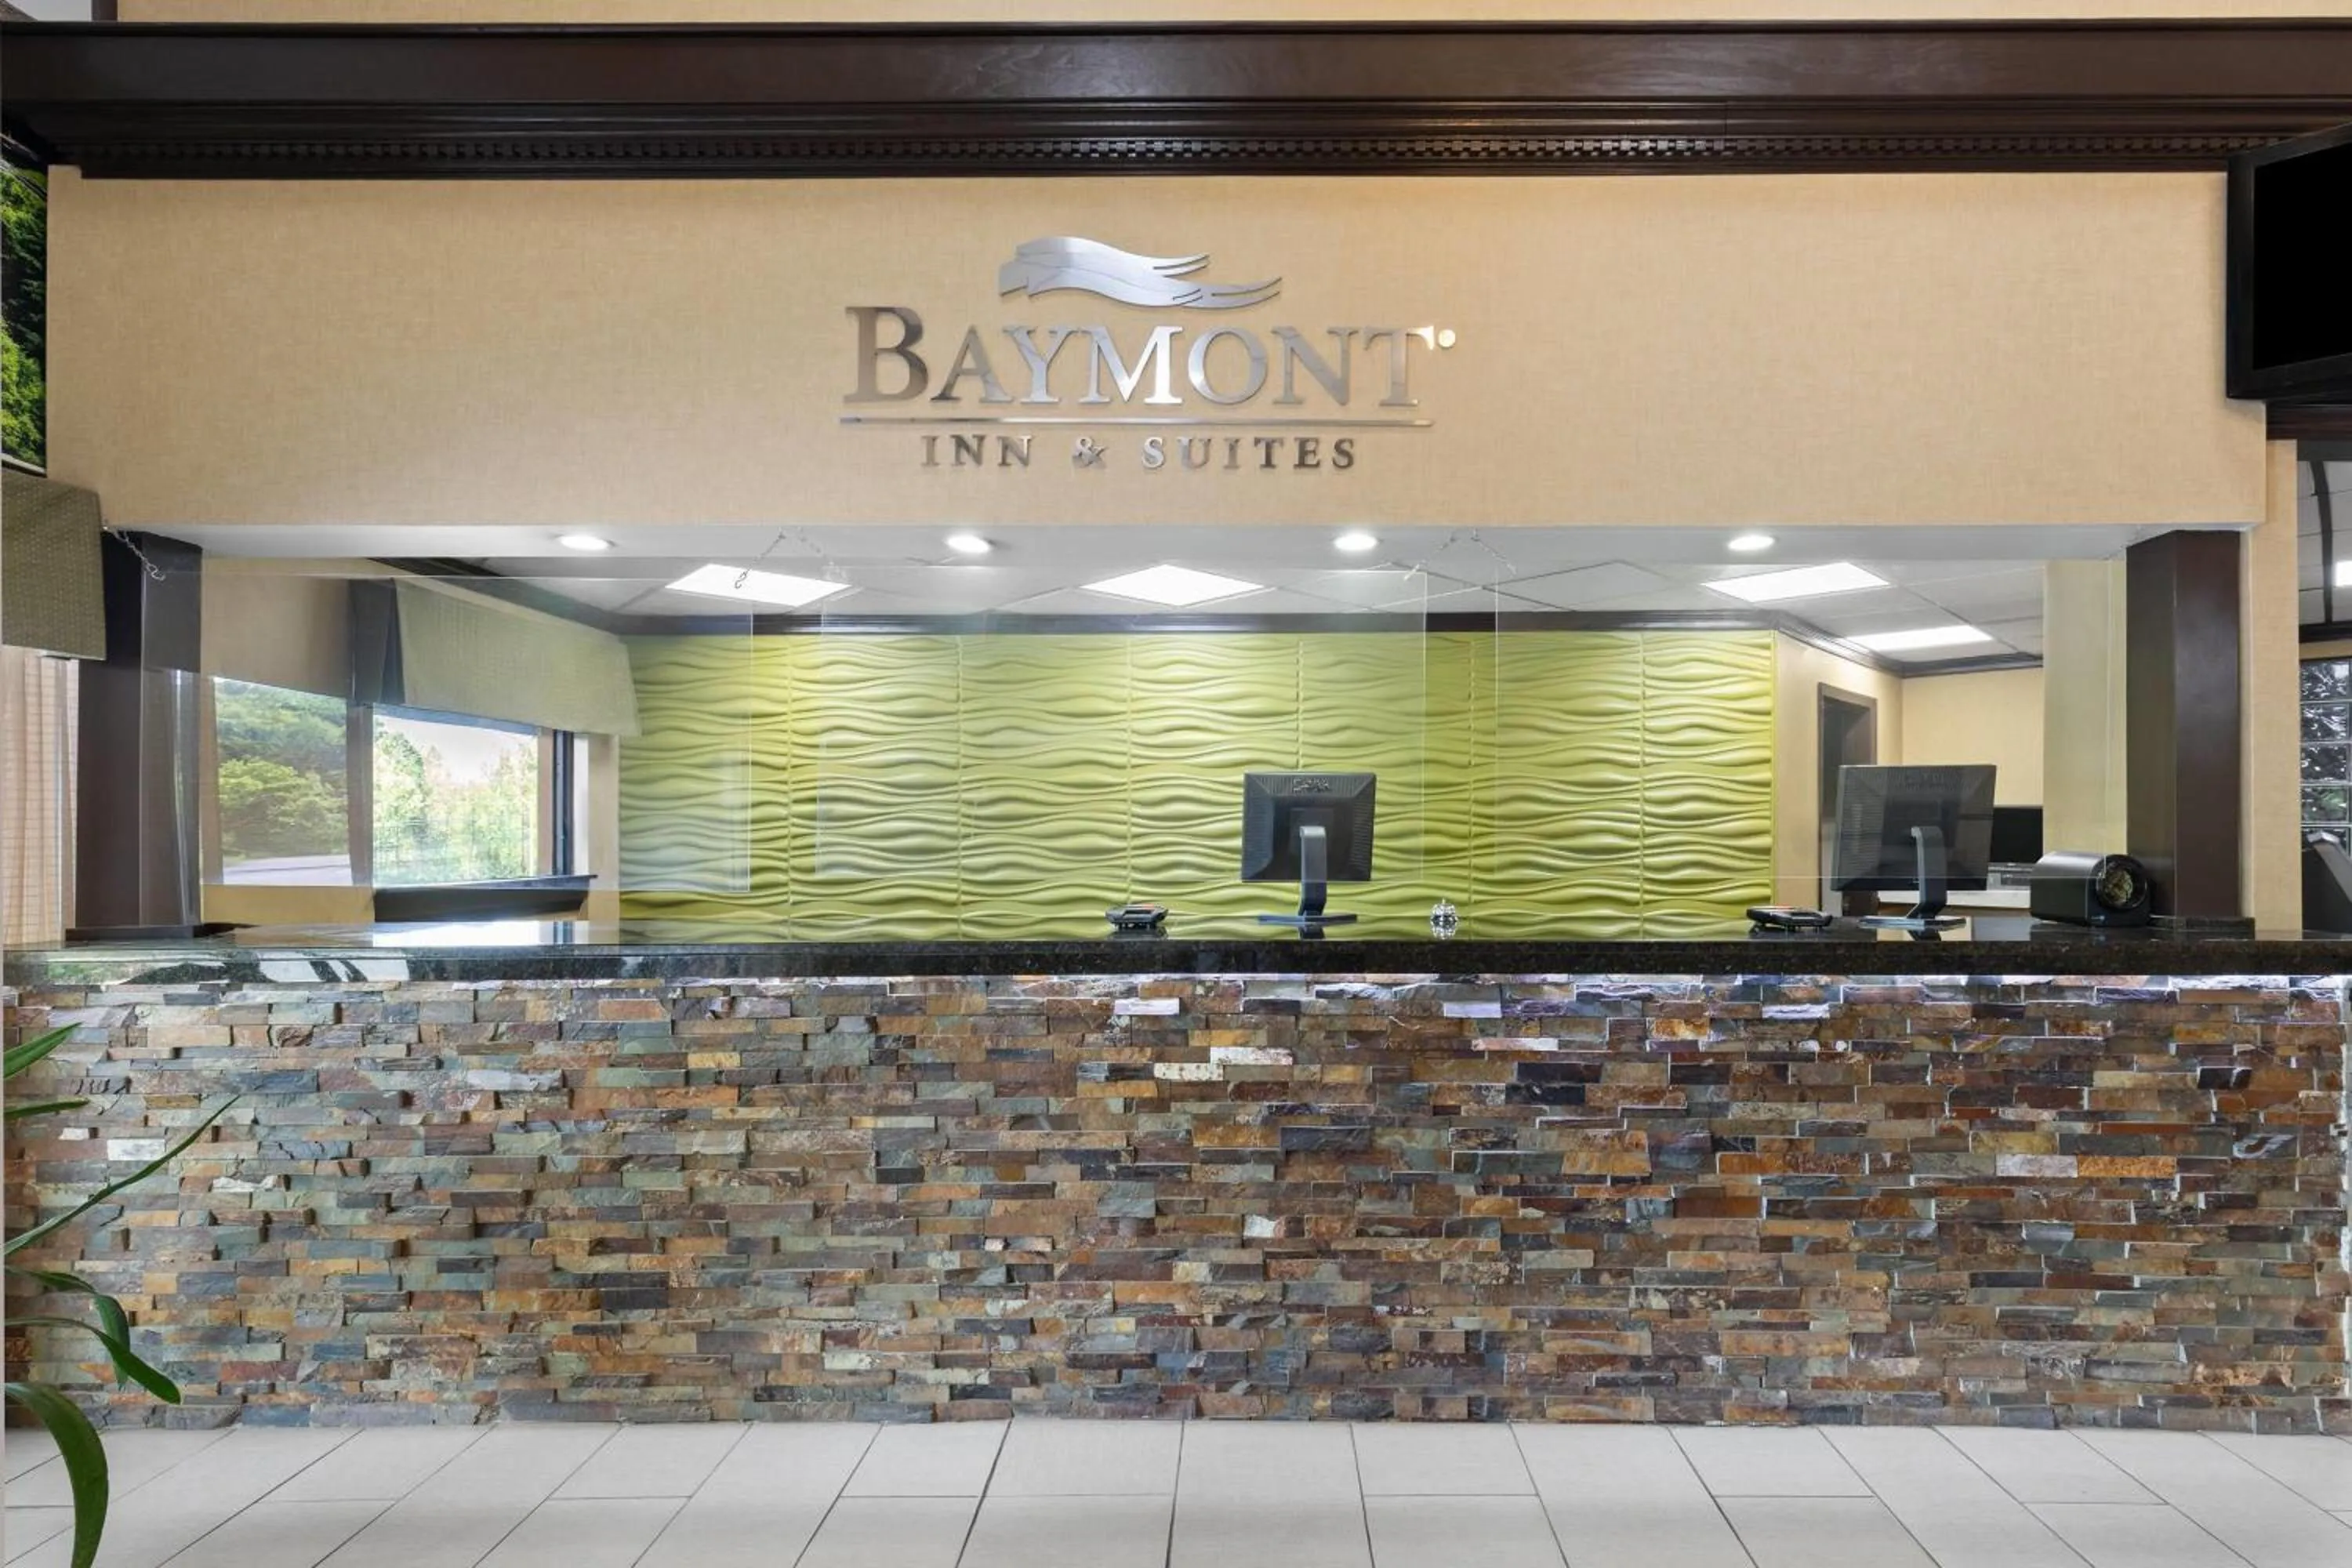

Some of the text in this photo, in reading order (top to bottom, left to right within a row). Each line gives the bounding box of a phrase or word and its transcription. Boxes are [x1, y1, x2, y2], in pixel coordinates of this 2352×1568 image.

[842, 306, 1436, 408] BAYMONT
[920, 434, 1356, 470] INN & SUITES
